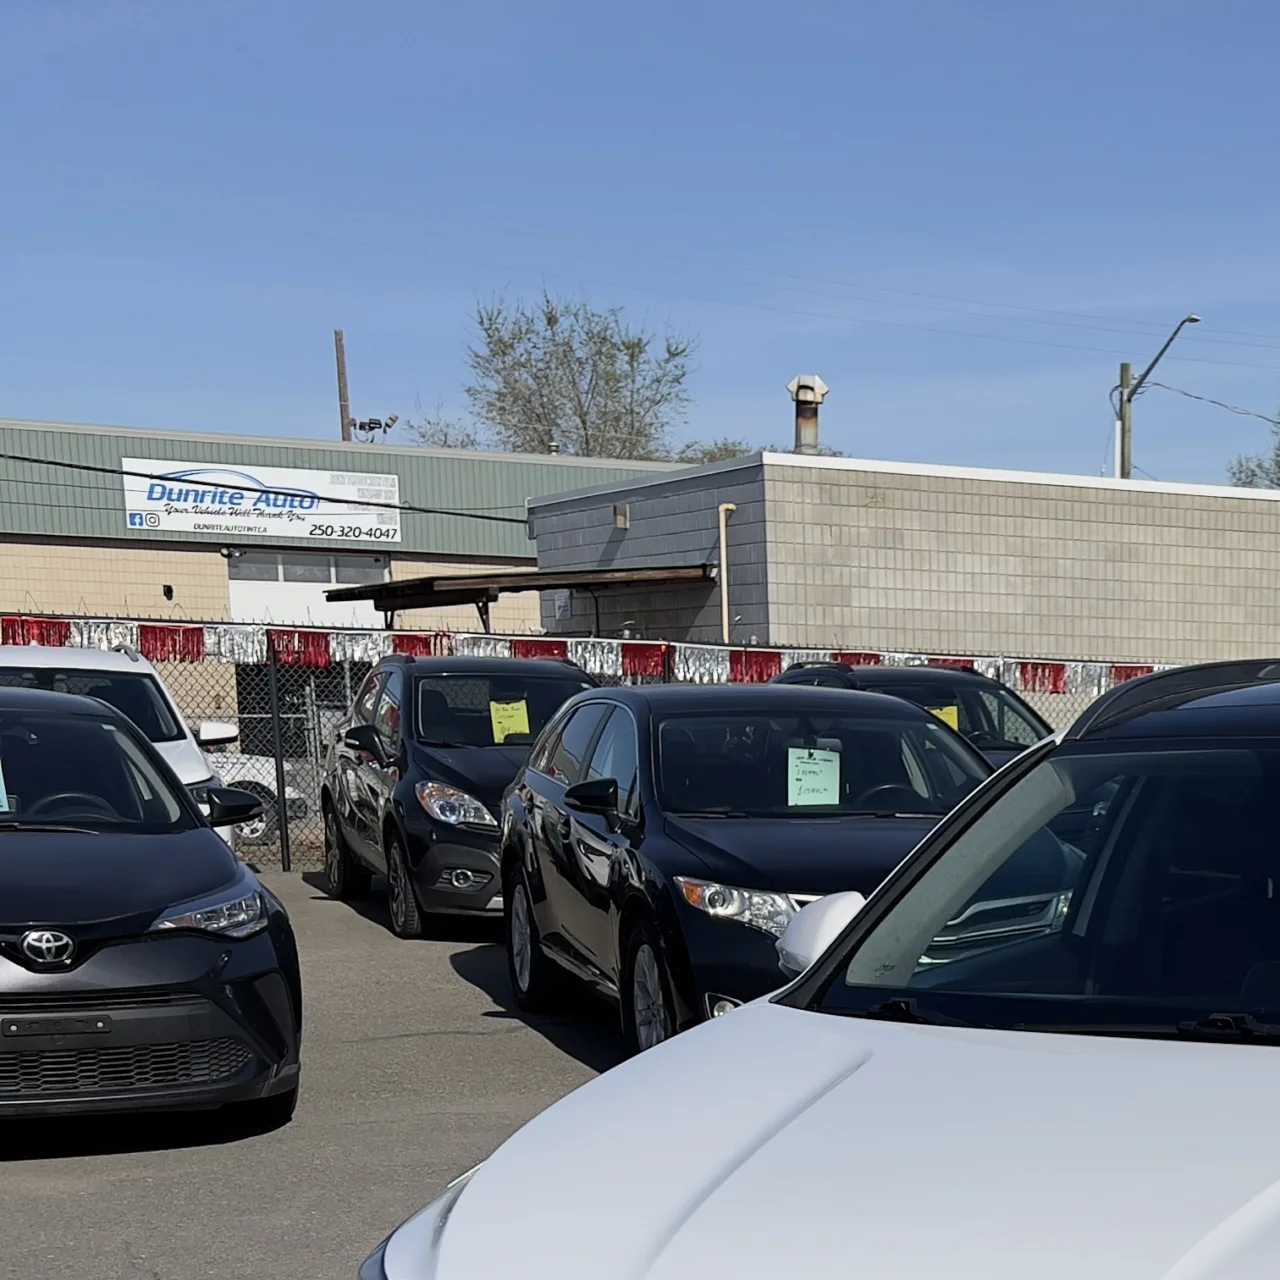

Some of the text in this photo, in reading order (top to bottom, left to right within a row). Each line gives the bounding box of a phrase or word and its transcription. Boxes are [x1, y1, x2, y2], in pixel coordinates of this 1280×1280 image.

[146, 483, 315, 509] Dunrite Auto
[163, 503, 189, 515] Your
[192, 505, 227, 516] Vehicle
[286, 510, 306, 522] You
[309, 524, 398, 540] 250-320-4047
